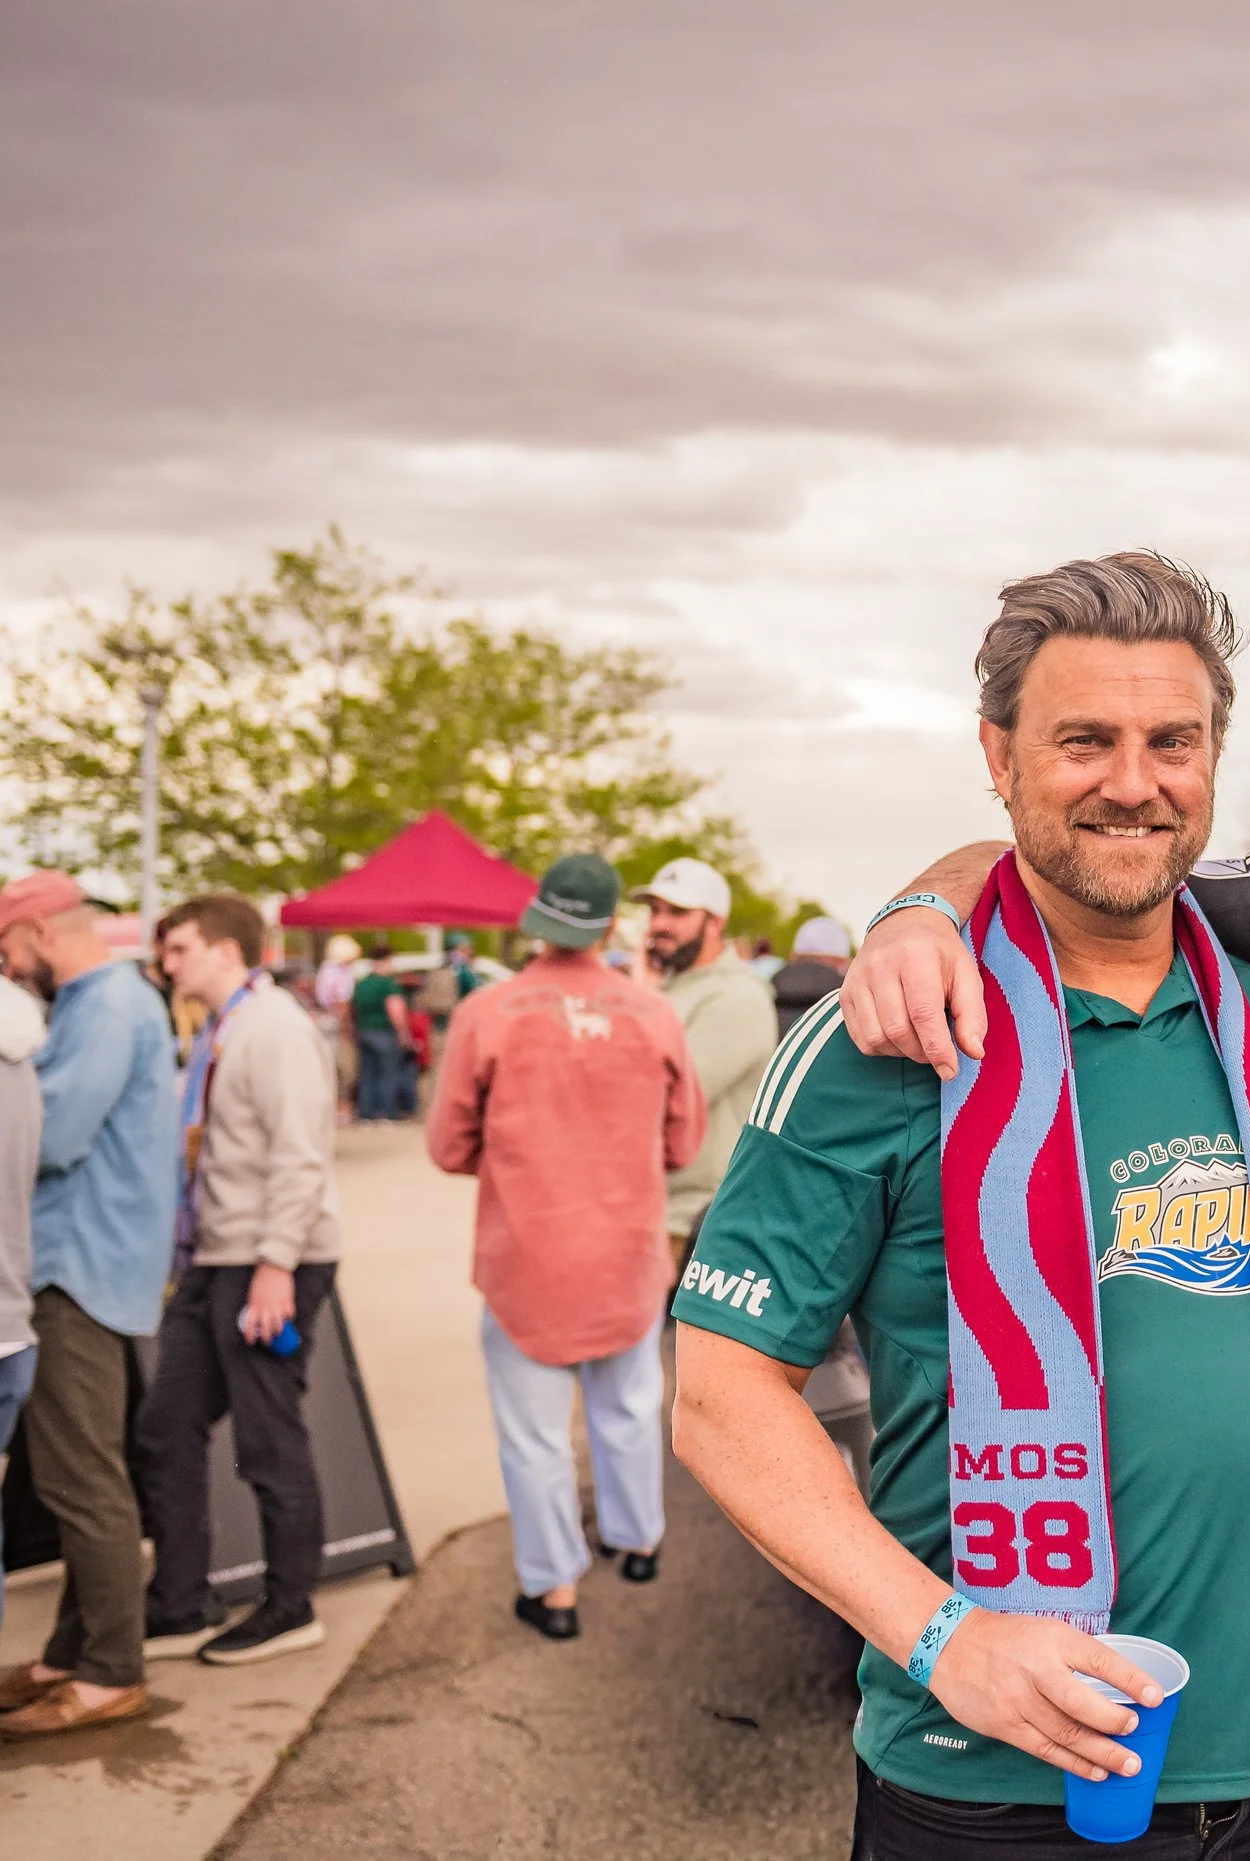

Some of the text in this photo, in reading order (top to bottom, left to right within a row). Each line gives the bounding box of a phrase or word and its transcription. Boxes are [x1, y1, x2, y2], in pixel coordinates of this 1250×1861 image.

[1109, 1133, 1246, 1183] COLORA
[953, 1500, 1094, 1589] 38
[923, 1733, 968, 1750] AEROREADY
